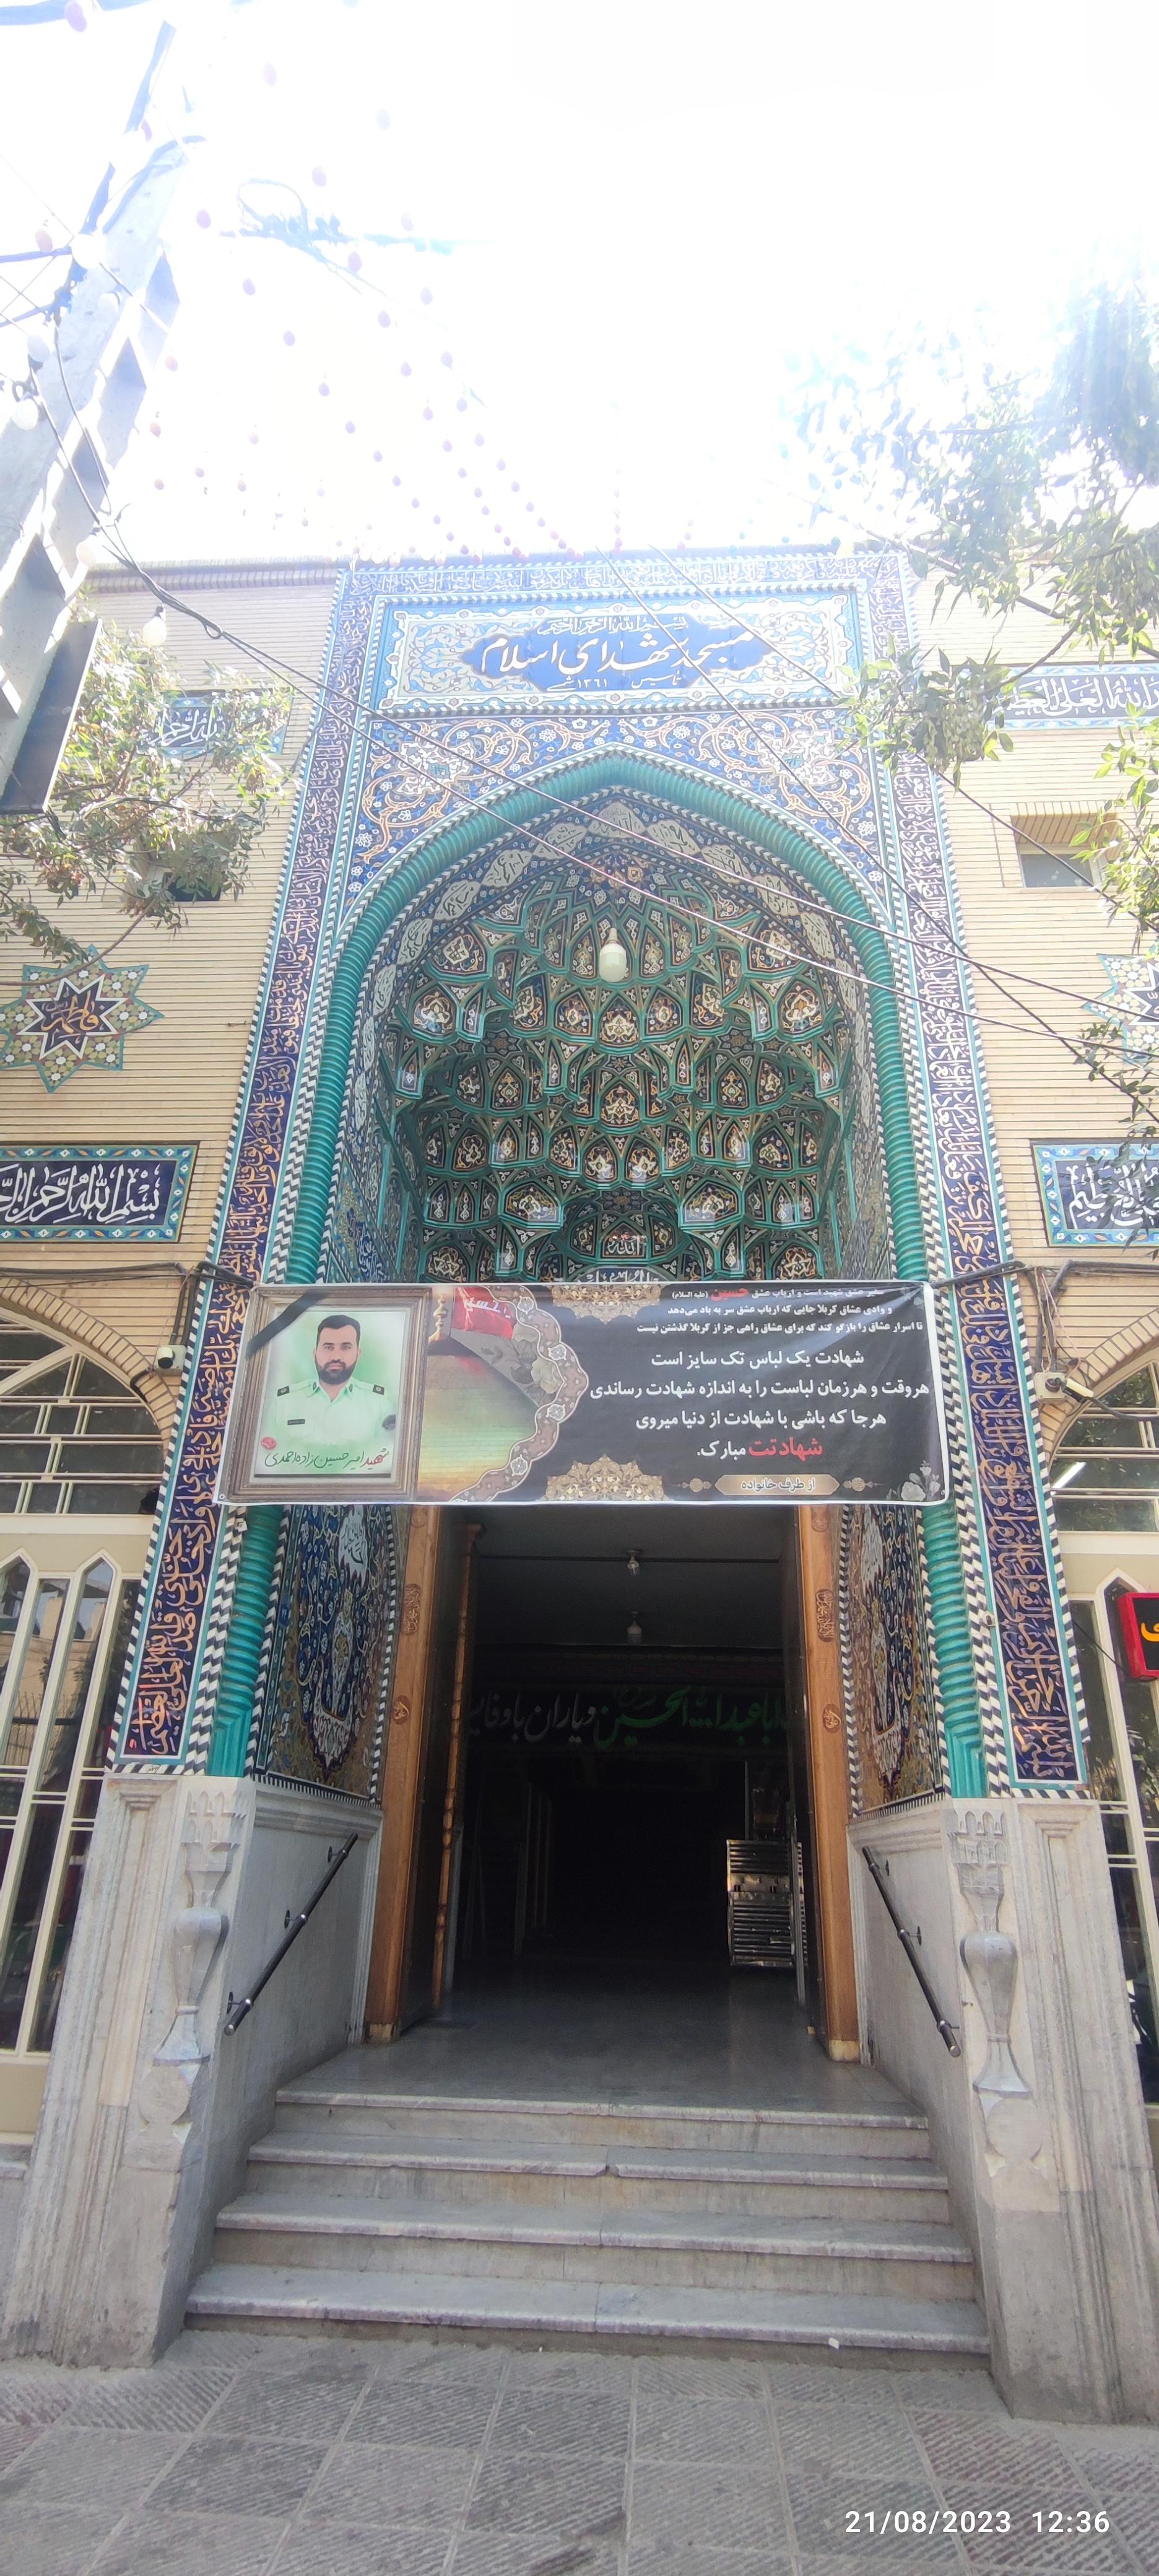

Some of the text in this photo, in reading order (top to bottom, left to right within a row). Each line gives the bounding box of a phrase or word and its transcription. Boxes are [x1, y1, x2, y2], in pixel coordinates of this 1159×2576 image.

[481, 630, 757, 675] مسجد شهدای اسلام
[711, 1287, 749, 1302] حسین
[752, 1289, 770, 1299] عشق
[700, 1305, 711, 1315] باد
[713, 1307, 721, 1315] به
[723, 1308, 734, 1316] سر
[736, 1305, 755, 1315] عشق
[757, 1304, 779, 1315] ارباب
[781, 1304, 792, 1313] که
[793, 1304, 815, 1316] جایی
[817, 1304, 838, 1316] کربلا
[839, 1304, 861, 1316] عشاق
[863, 1305, 885, 1315] وادی
[887, 1307, 893, 1315] و
[636, 1325, 659, 1334] نیست
[690, 1322, 711, 1334] کربلا
[712, 1322, 721, 1334] از
[722, 1323, 735, 1334] جز
[736, 1322, 759, 1334] راهی
[760, 1322, 783, 1334] عشاق
[784, 1323, 804, 1334] برای
[805, 1323, 816, 1331] که
[818, 1323, 833, 1332] کند
[857, 1322, 867, 1333] را
[868, 1321, 890, 1333] عشاق
[892, 1321, 914, 1333] اسرار
[916, 1321, 923, 1331] تا
[651, 1349, 864, 1370] شهادت یک لباس تک سایز است
[589, 1380, 643, 1400] رساندی
[646, 1380, 695, 1399] شهادت
[699, 1380, 736, 1398] اندازه
[739, 1383, 752, 1398] به
[755, 1379, 767, 1398] را
[771, 1379, 814, 1398] لباست
[870, 1385, 878, 1398] و
[636, 1414, 679, 1430] میروی
[682, 1410, 705, 1429] دنیا
[708, 1409, 721, 1429] از
[724, 1409, 775, 1429] شهادت
[777, 1409, 788, 1429] با
[791, 1409, 825, 1430] باشی
[828, 1409, 848, 1424] که
[361, 1448, 390, 1470] شهید
[740, 1477, 816, 1493] از طرف خانواده
